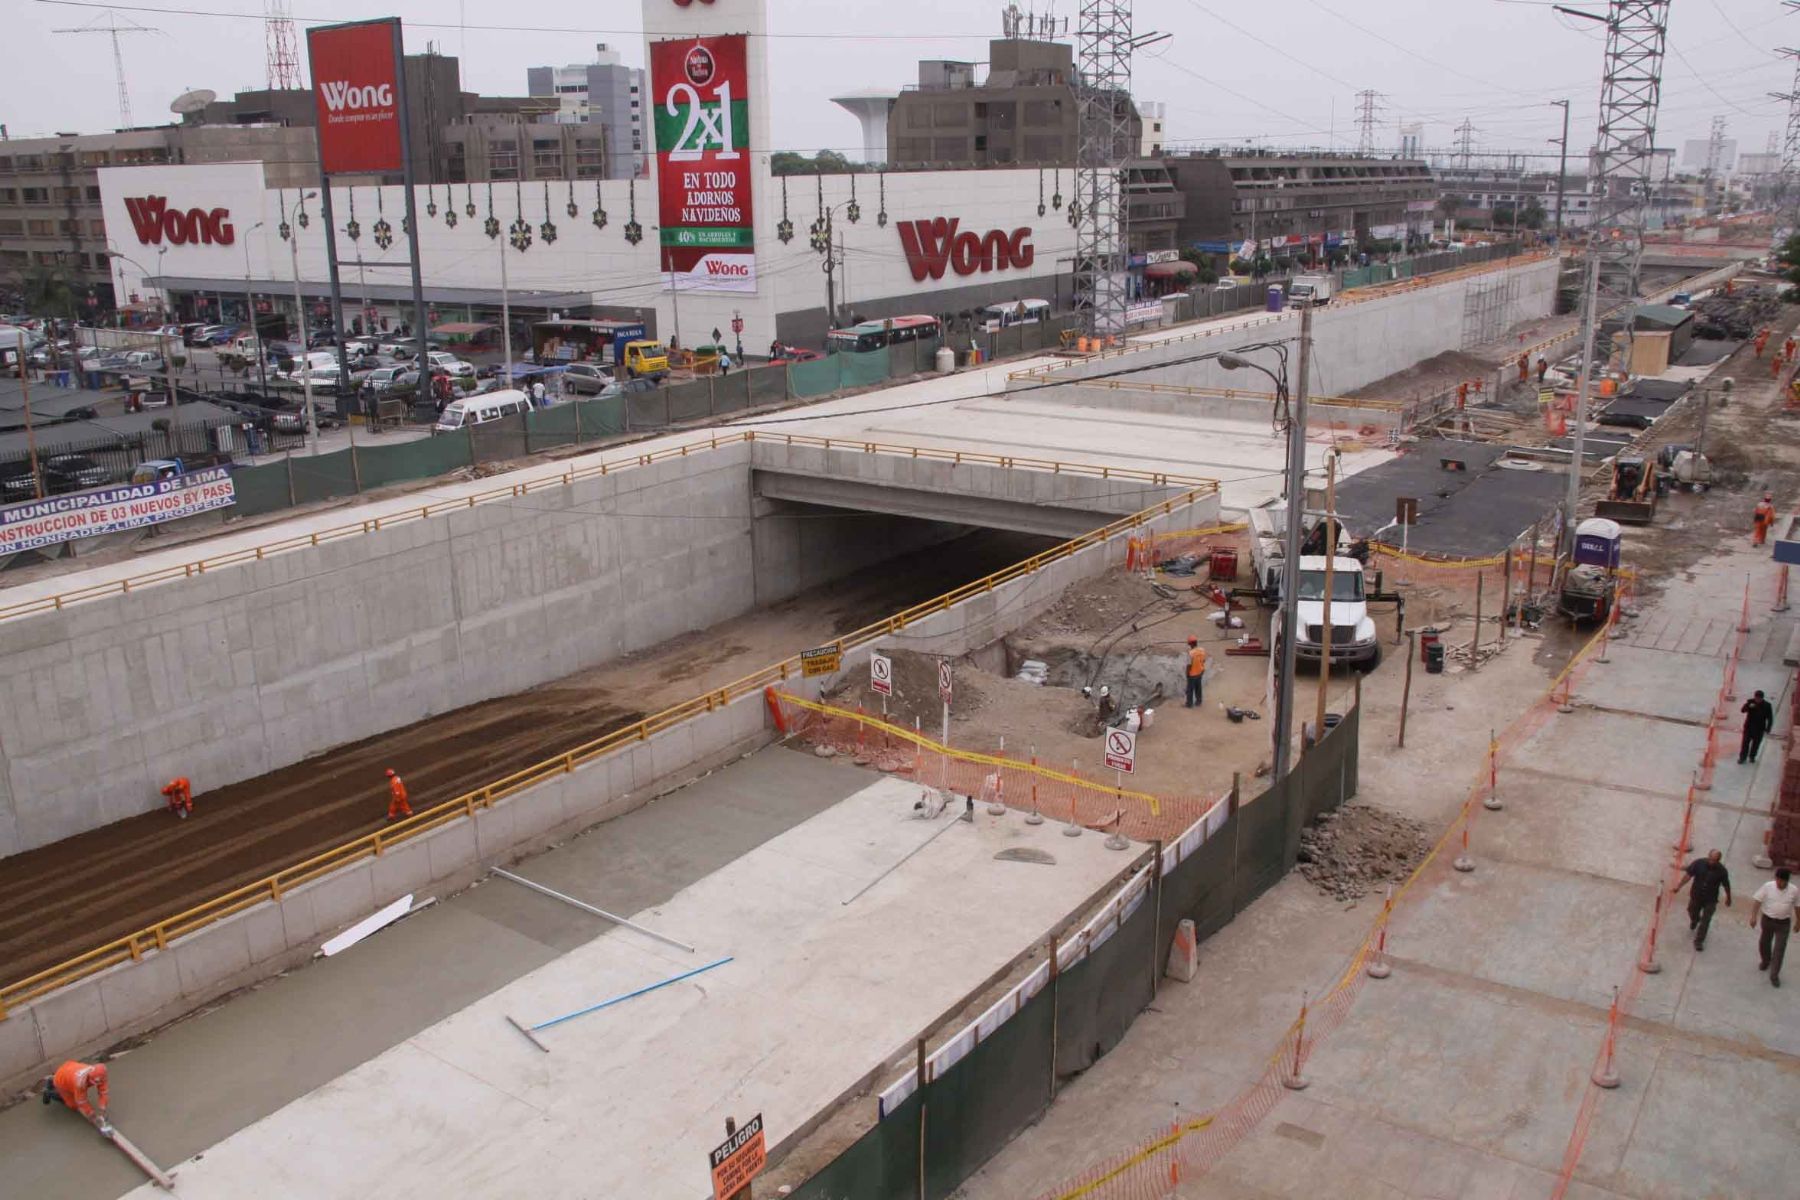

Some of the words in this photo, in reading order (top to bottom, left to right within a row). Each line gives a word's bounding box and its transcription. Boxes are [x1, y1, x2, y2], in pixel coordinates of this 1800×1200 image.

[666, 80, 740, 161] 2x1
[683, 172, 700, 189] EN
[704, 172, 736, 189] TODO
[682, 206, 741, 222] NAVIDEÑOS
[687, 191, 734, 206] ADORNOS
[4, 485, 155, 523] MUNICIPALIDAD
[160, 479, 181, 493] DE
[185, 468, 229, 487] LIMA
[90, 510, 108, 523] DE
[111, 506, 127, 520] 03
[130, 496, 180, 516] NUEVOS
[184, 491, 200, 504] BY
[203, 483, 233, 499] PASS
[155, 496, 233, 521] PROSPERA
[714, 1119, 759, 1164] PELIGRO
